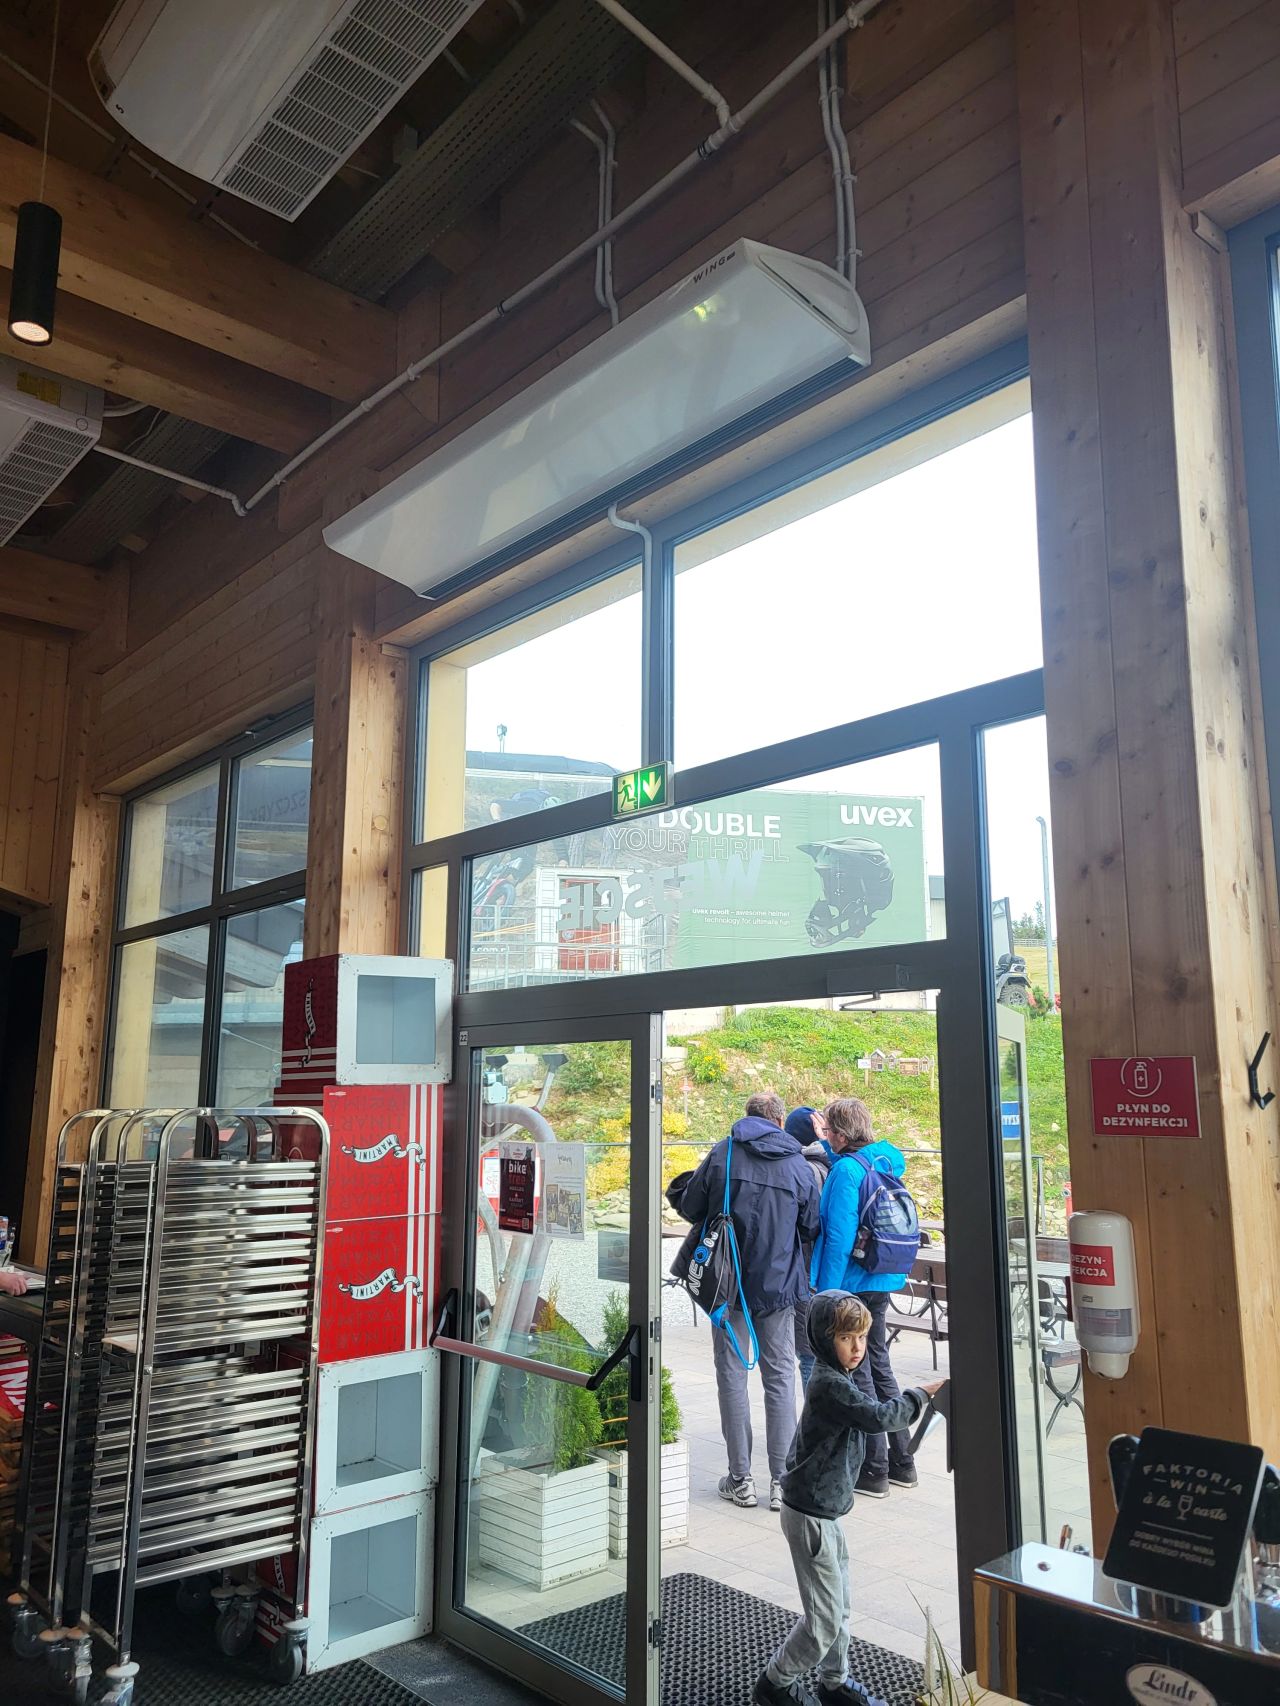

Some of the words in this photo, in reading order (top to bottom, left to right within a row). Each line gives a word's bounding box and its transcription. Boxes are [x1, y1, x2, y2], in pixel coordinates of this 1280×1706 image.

[693, 256, 728, 284] WING
[658, 806, 782, 838] DOUBLE
[840, 803, 915, 828] uvex
[607, 827, 687, 853] YOUR
[690, 836, 790, 863] THRILL
[704, 917, 740, 925] technology
[1117, 1103, 1150, 1113] PŁYN
[1152, 1104, 1171, 1114] DO
[1103, 1117, 1188, 1128] DEZYNFEKCJI
[358, 1138, 394, 1160] MARTINI
[509, 1160, 527, 1175] bike
[355, 1272, 391, 1297] MARTINI
[1143, 1464, 1243, 1495] FAKTORIA
[1170, 1479, 1208, 1496] WIN
